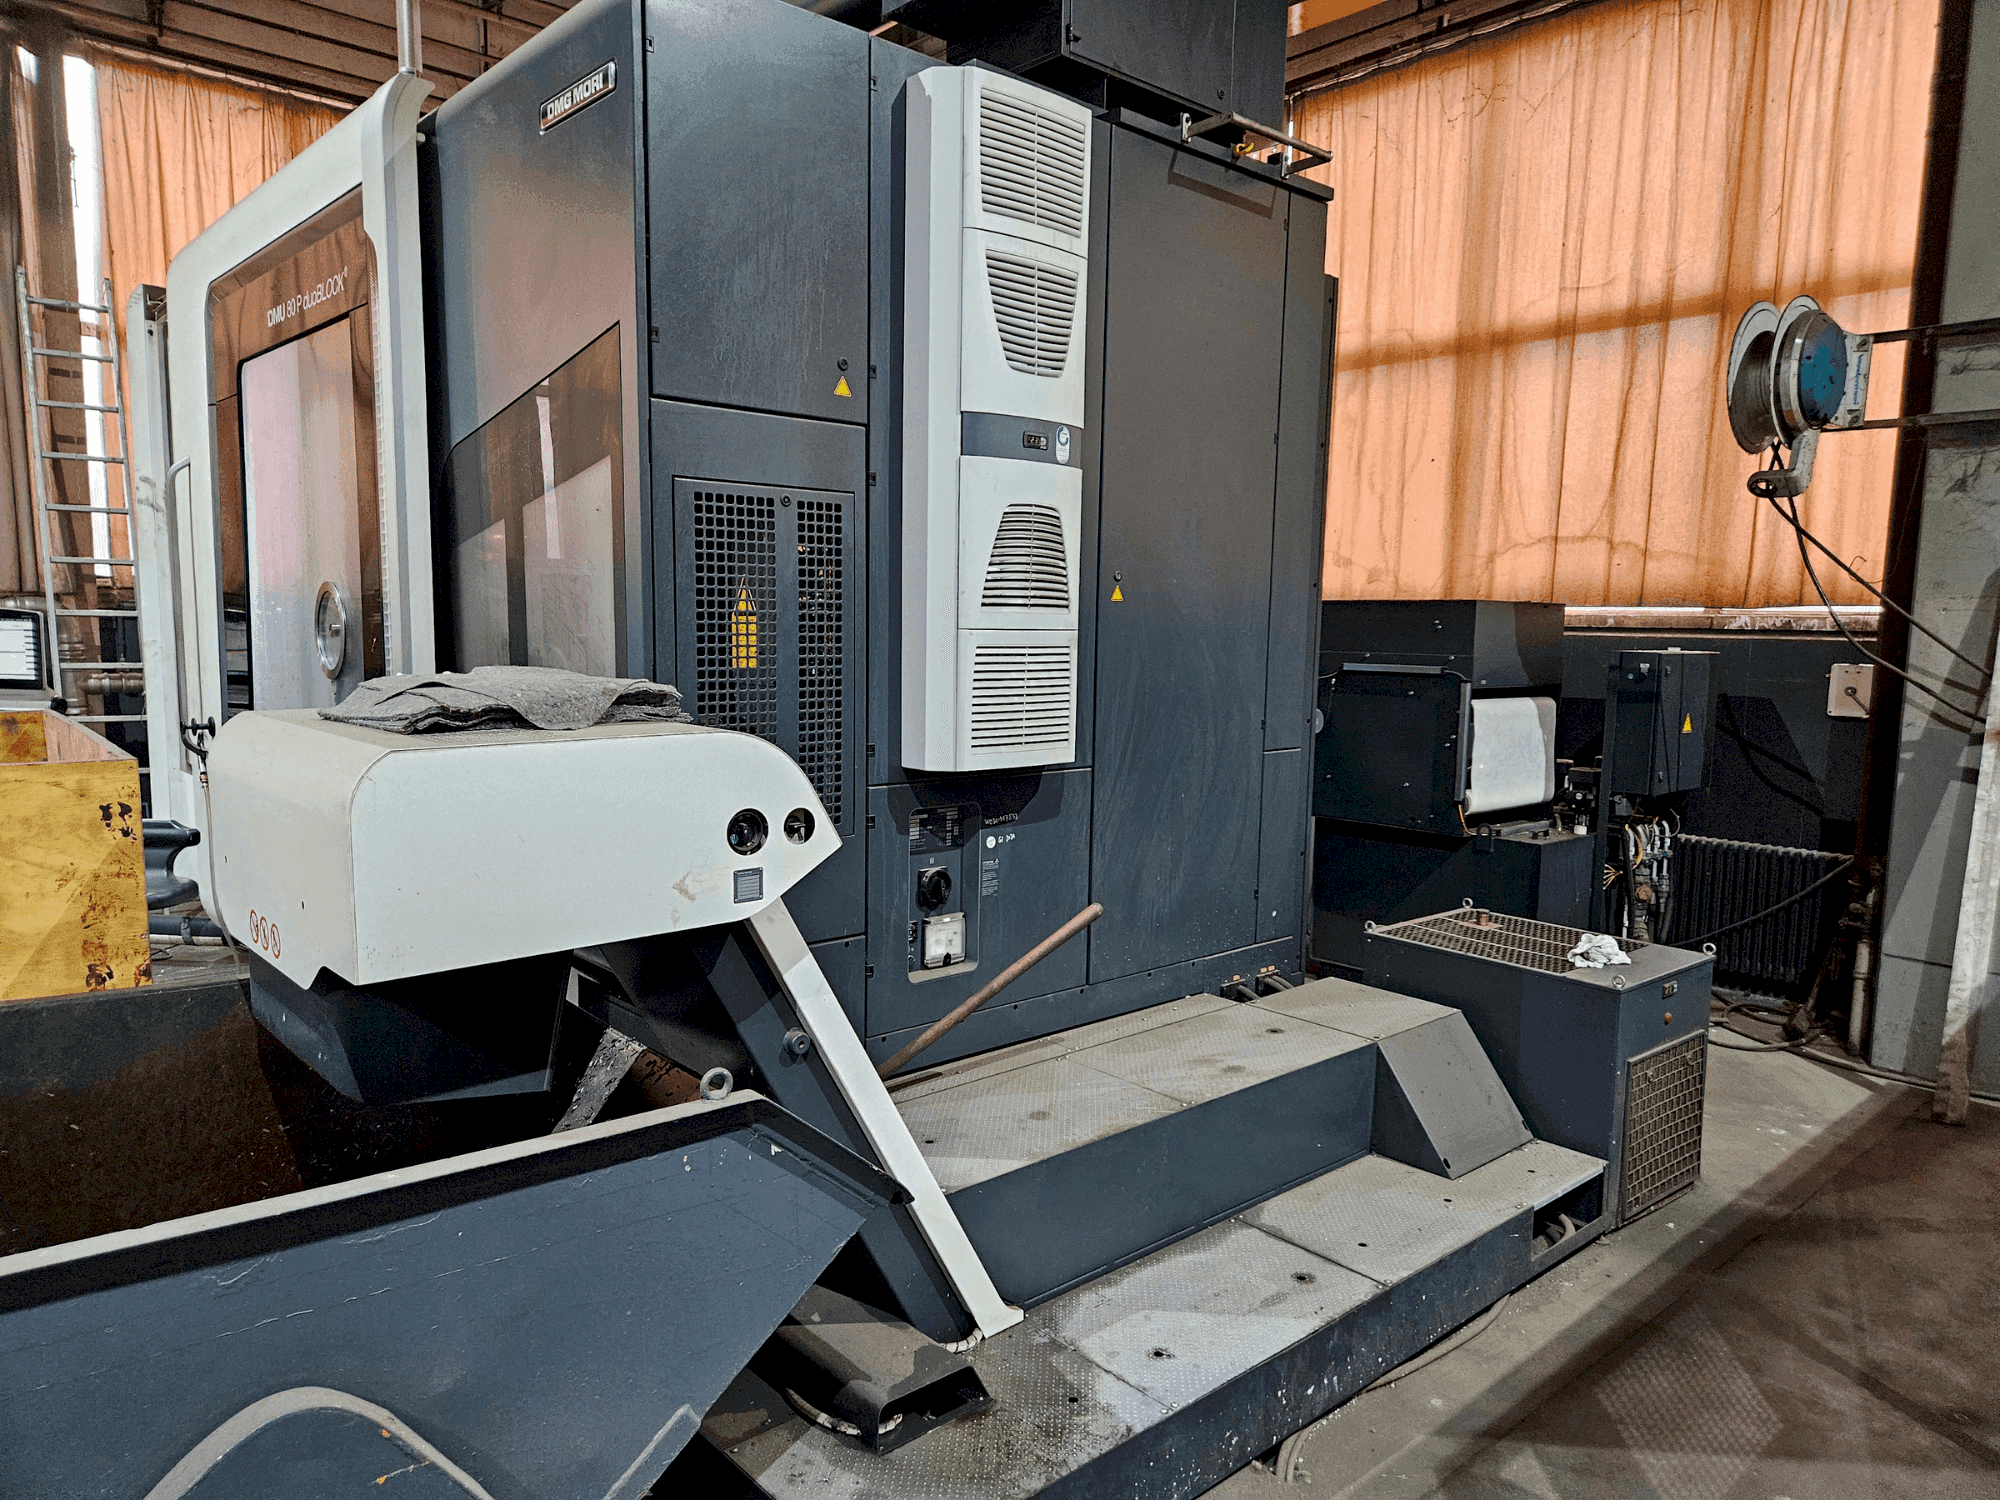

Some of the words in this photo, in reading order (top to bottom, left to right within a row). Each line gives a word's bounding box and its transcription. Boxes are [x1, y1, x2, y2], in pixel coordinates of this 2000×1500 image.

[547, 90, 572, 120] DMG
[573, 71, 604, 105] MORI
[267, 303, 286, 328] DMU
[286, 298, 296, 318] 80
[296, 294, 302, 313] P
